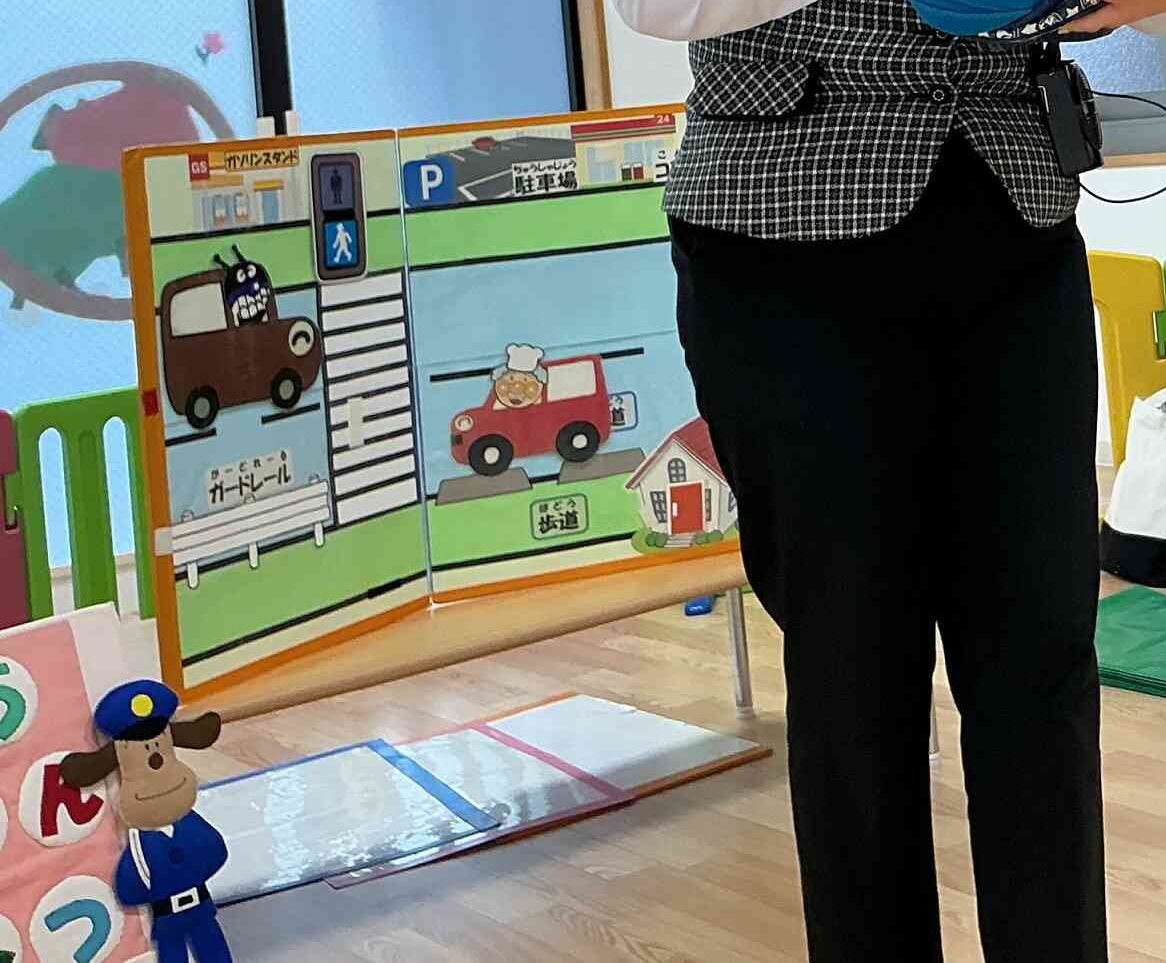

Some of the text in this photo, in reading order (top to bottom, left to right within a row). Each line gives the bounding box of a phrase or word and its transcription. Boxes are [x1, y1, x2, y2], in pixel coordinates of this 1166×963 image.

[191, 160, 208, 174] GS
[226, 150, 298, 169] ガソリンスタンド
[419, 163, 443, 201] P
[515, 170, 578, 194] 駐車場
[209, 463, 292, 504] ガードレール
[538, 509, 579, 534] 歩道
